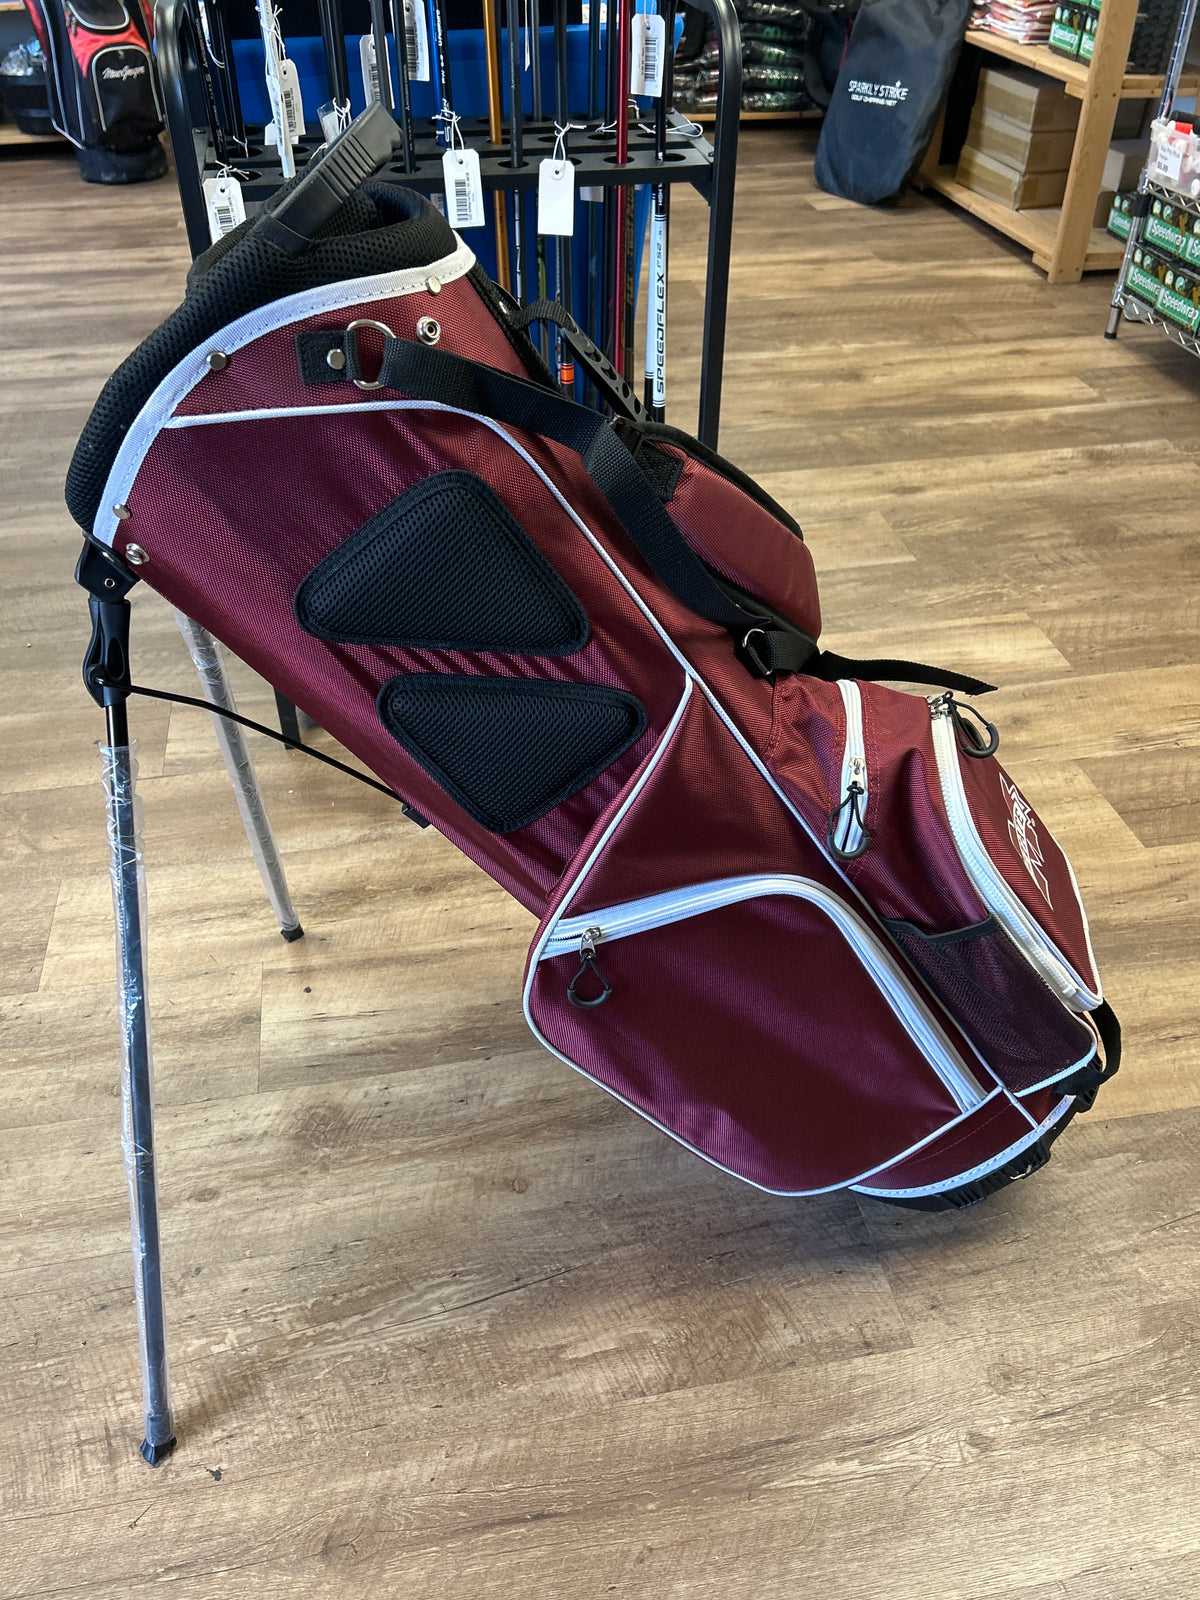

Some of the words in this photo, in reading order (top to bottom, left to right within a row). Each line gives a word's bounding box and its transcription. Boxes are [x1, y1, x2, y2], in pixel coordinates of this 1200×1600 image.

[1151, 219, 1187, 255] Speedwrap
[1132, 267, 1160, 296] Speedwra
[1162, 290, 1199, 327] Speedwrap
[656, 272, 665, 394] SPEEDFLEX
